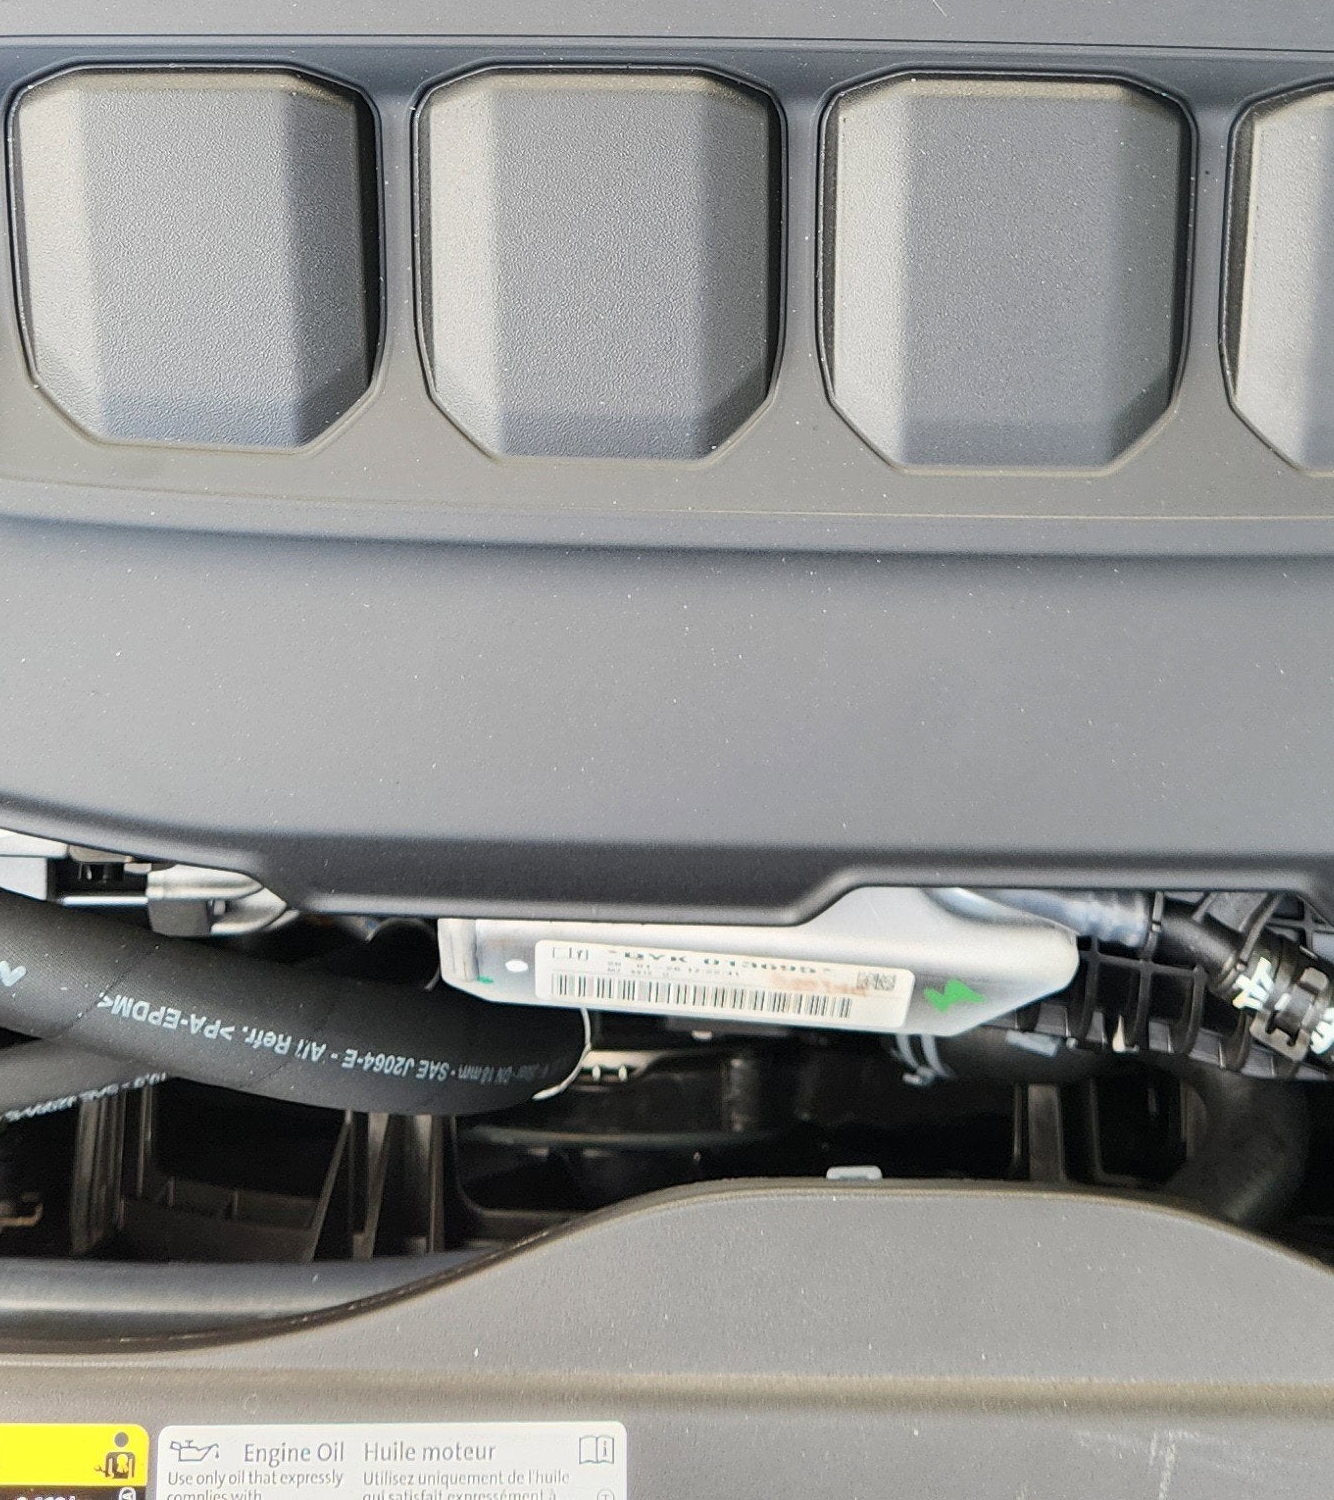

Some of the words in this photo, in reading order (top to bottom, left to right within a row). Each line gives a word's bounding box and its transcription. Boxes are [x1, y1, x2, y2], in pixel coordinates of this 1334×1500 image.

[242, 1025, 292, 1053] Refr.
[418, 1059, 449, 1079] SAE
[244, 1442, 311, 1468] Engine
[317, 1442, 345, 1462] Oil
[364, 1442, 416, 1462] Huile
[422, 1442, 495, 1462] moteur
[167, 1471, 193, 1485] Use
[195, 1471, 225, 1489] only
[228, 1471, 245, 1485] oil
[249, 1471, 276, 1485] that
[280, 1470, 344, 1487] expressly
[363, 1470, 414, 1486] Utilisez
[418, 1469, 503, 1492] uniquement
[507, 1469, 525, 1485] de
[528, 1469, 569, 1485] l'huile
